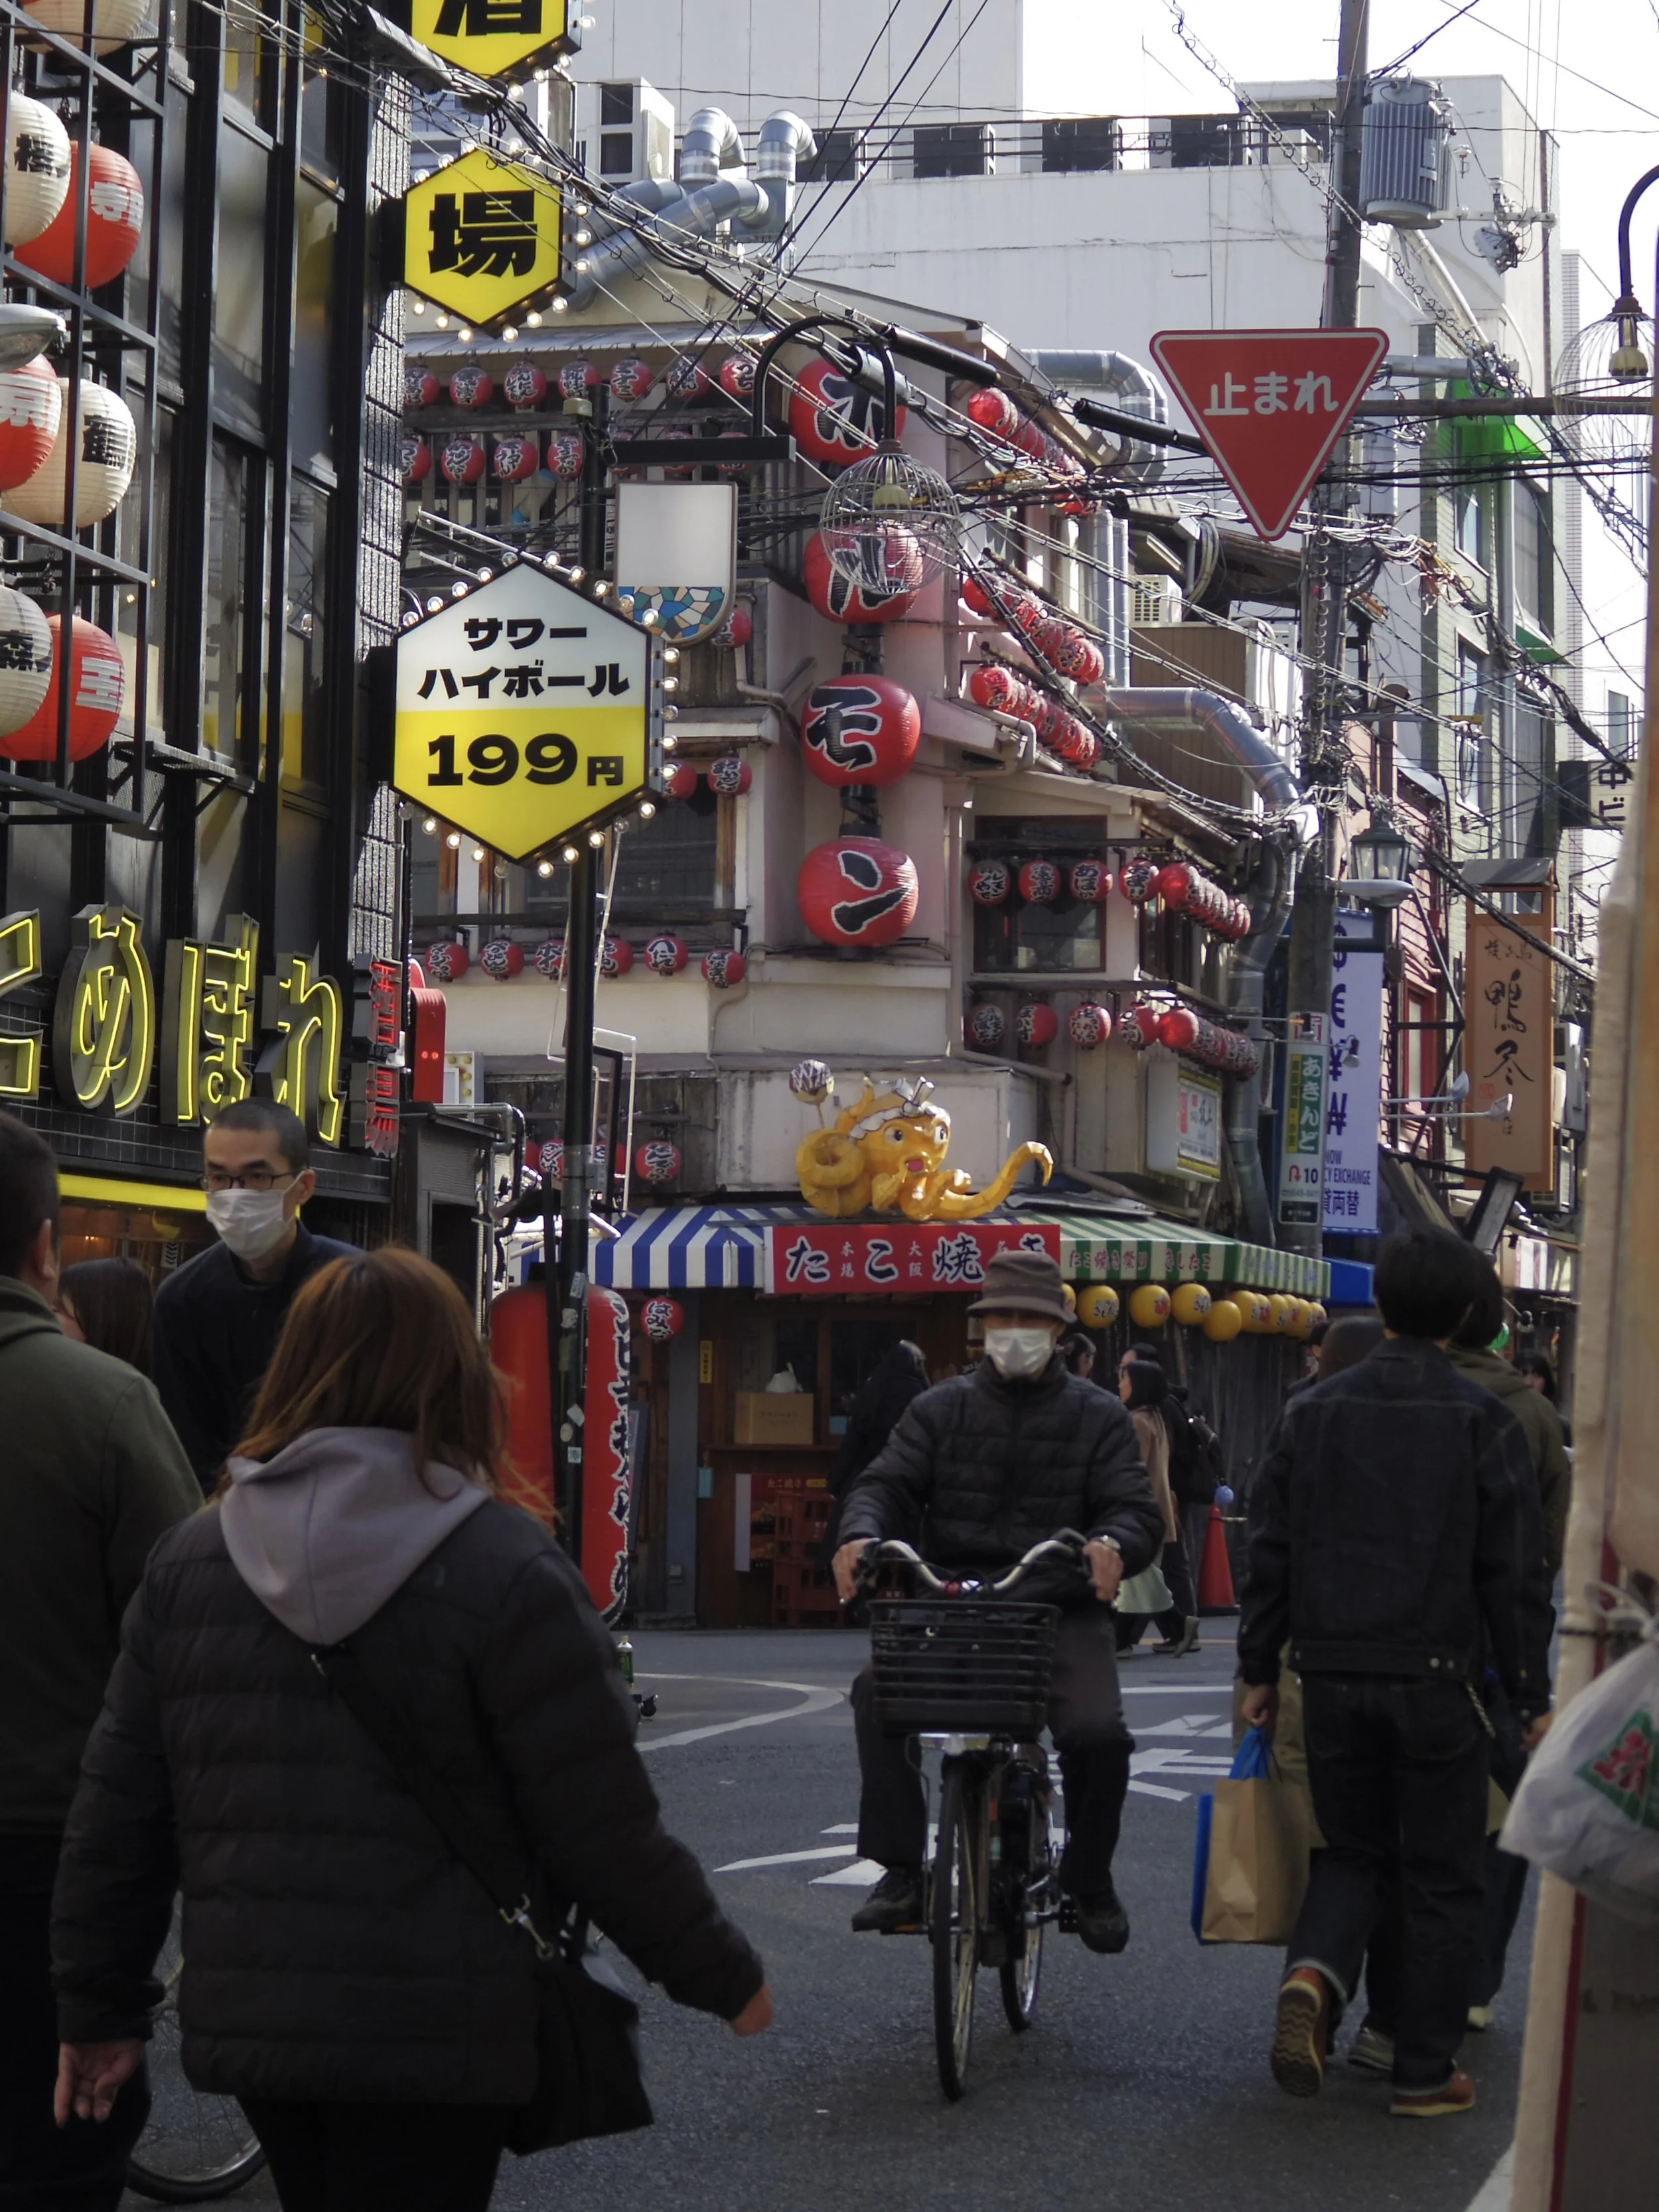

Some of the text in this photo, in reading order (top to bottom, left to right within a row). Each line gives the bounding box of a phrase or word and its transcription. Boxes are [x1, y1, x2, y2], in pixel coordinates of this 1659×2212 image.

[428, 190, 538, 278] 場
[1203, 370, 1338, 416] 止まれ
[463, 617, 587, 652] サワー
[417, 659, 630, 700] ハイボール
[428, 732, 624, 786] 199円
[1298, 1056, 1322, 1151] あきんど
[1304, 1167, 1319, 1184] 10
[1334, 1168, 1371, 1186] EXCHANGE
[908, 1240, 923, 1278] 大阪
[1069, 1248, 1148, 1271] たこ焼き祭り
